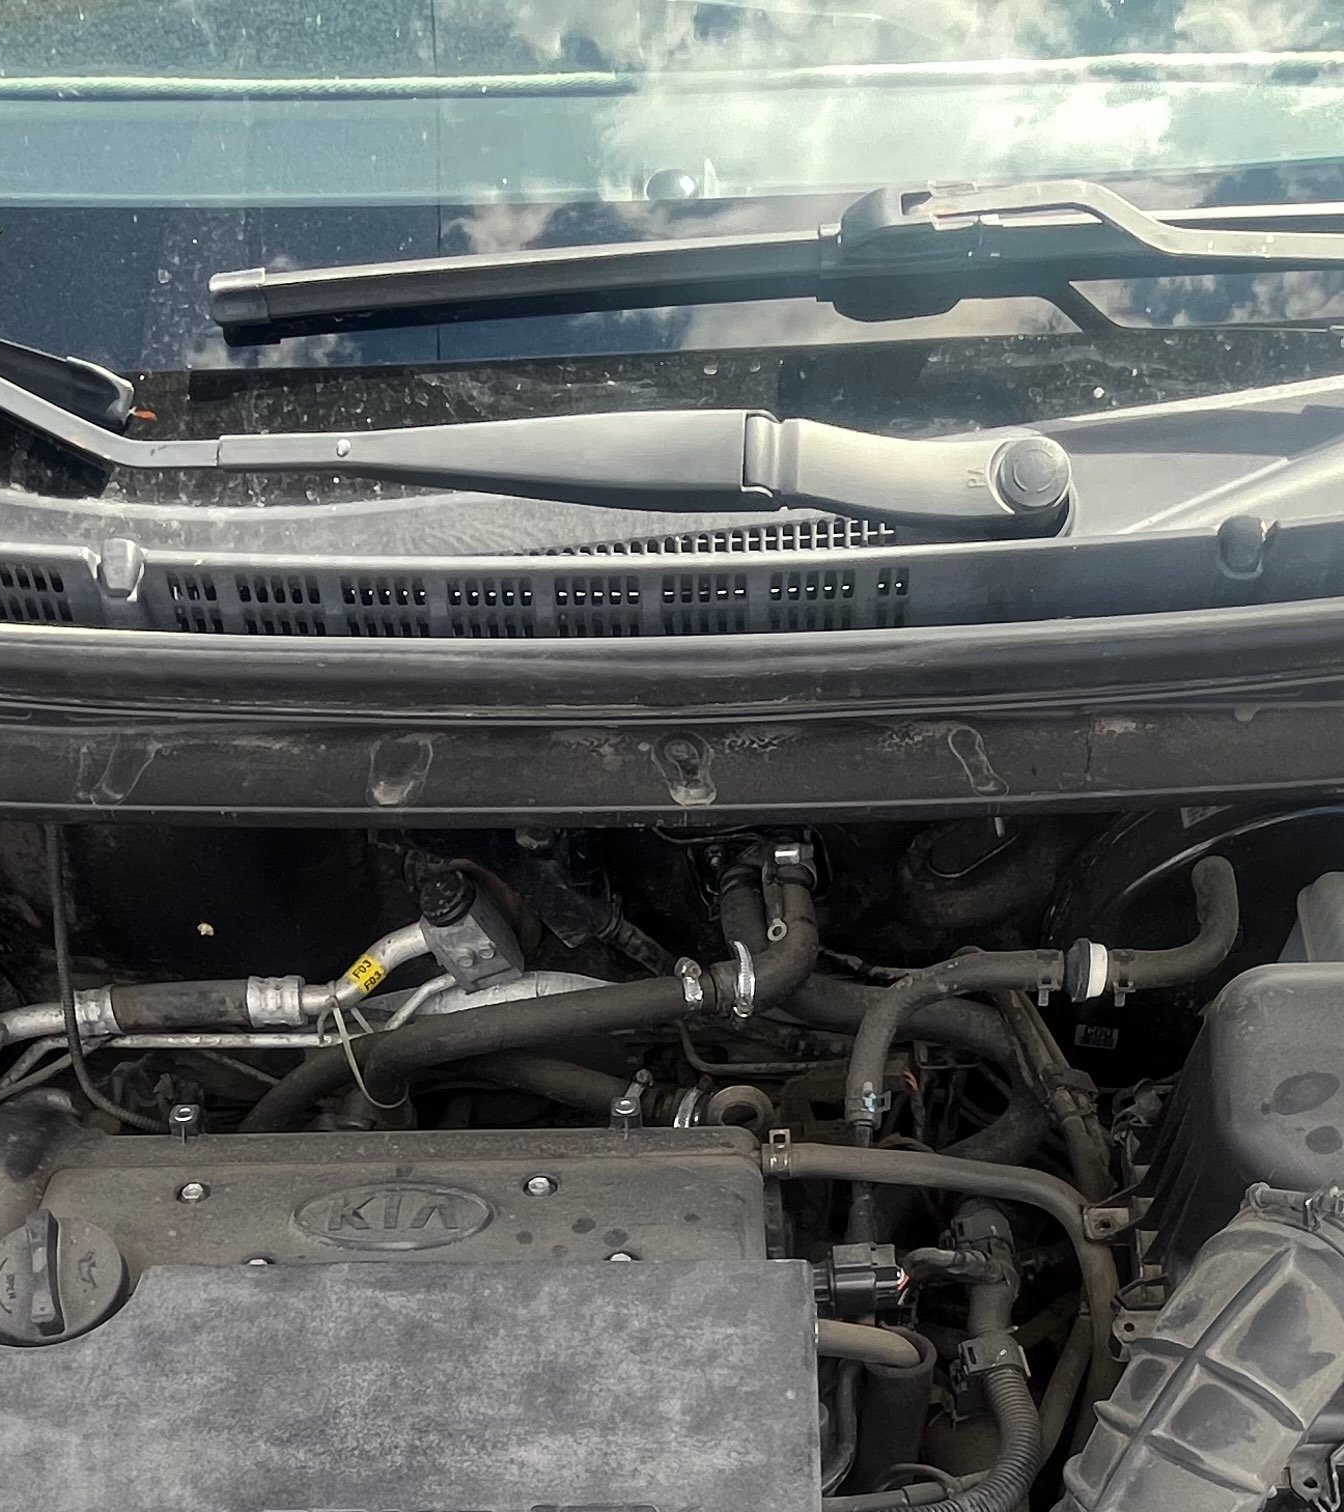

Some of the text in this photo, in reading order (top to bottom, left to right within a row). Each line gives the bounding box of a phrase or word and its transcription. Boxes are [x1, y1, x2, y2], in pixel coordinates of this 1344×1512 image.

[351, 959, 373, 979] F03
[327, 1191, 459, 1231] KIA
[5, 1274, 17, 1300] OPEN
